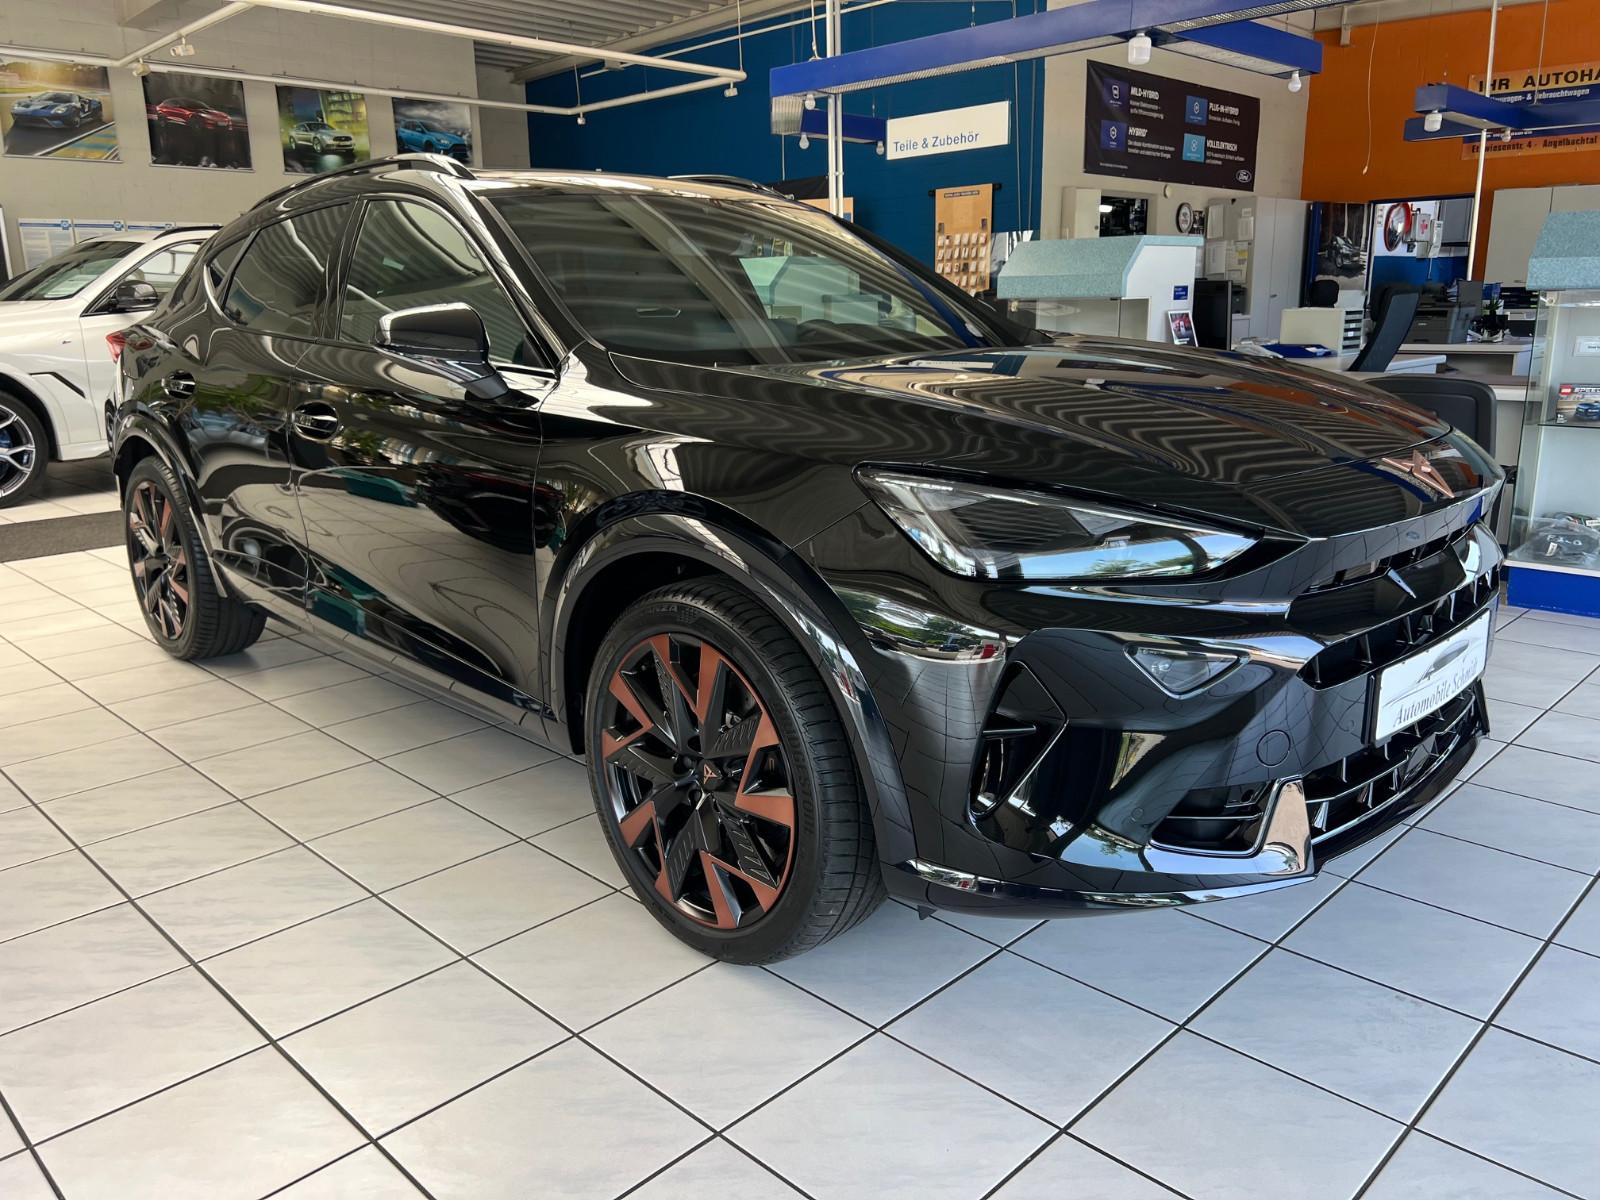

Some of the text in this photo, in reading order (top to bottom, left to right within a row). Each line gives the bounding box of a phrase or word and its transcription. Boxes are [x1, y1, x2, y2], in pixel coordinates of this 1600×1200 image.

[1130, 86, 1160, 100] MILD-HYBRID
[893, 131, 980, 153] Teile & Zubehör
[1393, 680, 1451, 727] Automobile
